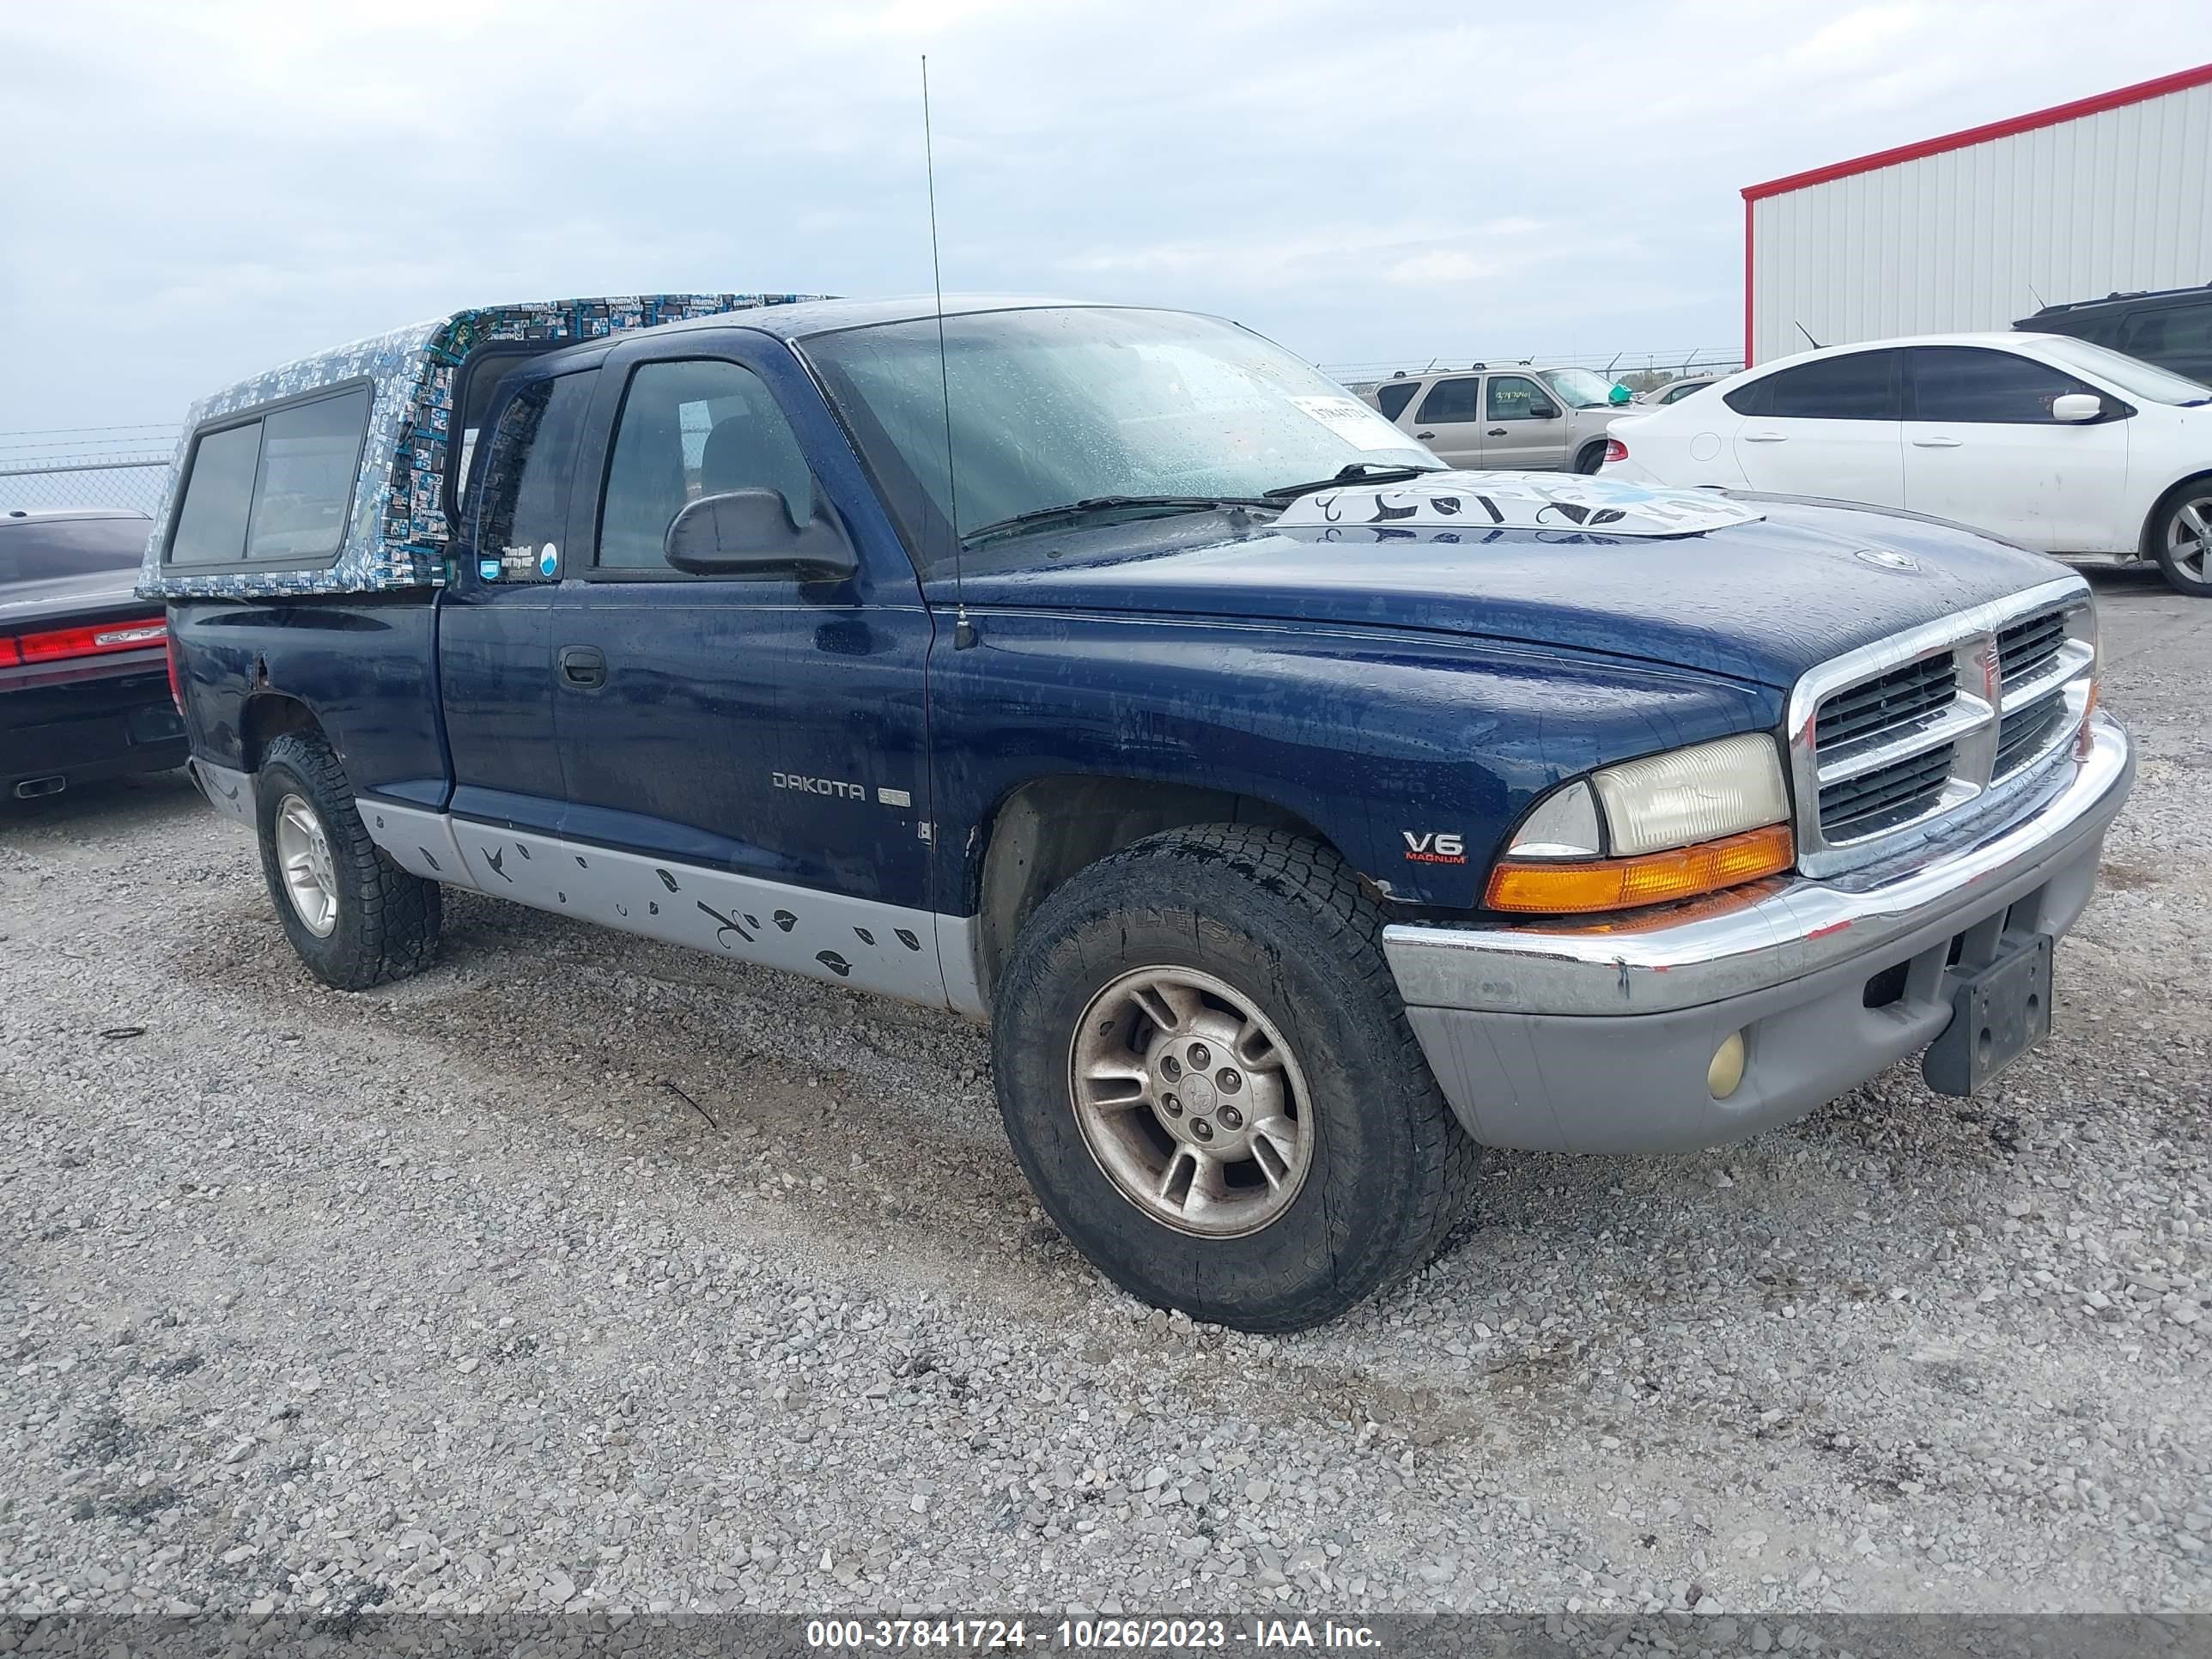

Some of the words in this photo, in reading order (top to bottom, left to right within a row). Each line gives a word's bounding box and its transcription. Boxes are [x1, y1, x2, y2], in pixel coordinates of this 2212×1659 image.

[773, 772, 866, 801] DAKOTA
[1402, 831, 1463, 856] V6
[1406, 853, 1466, 864] MAGNUM
